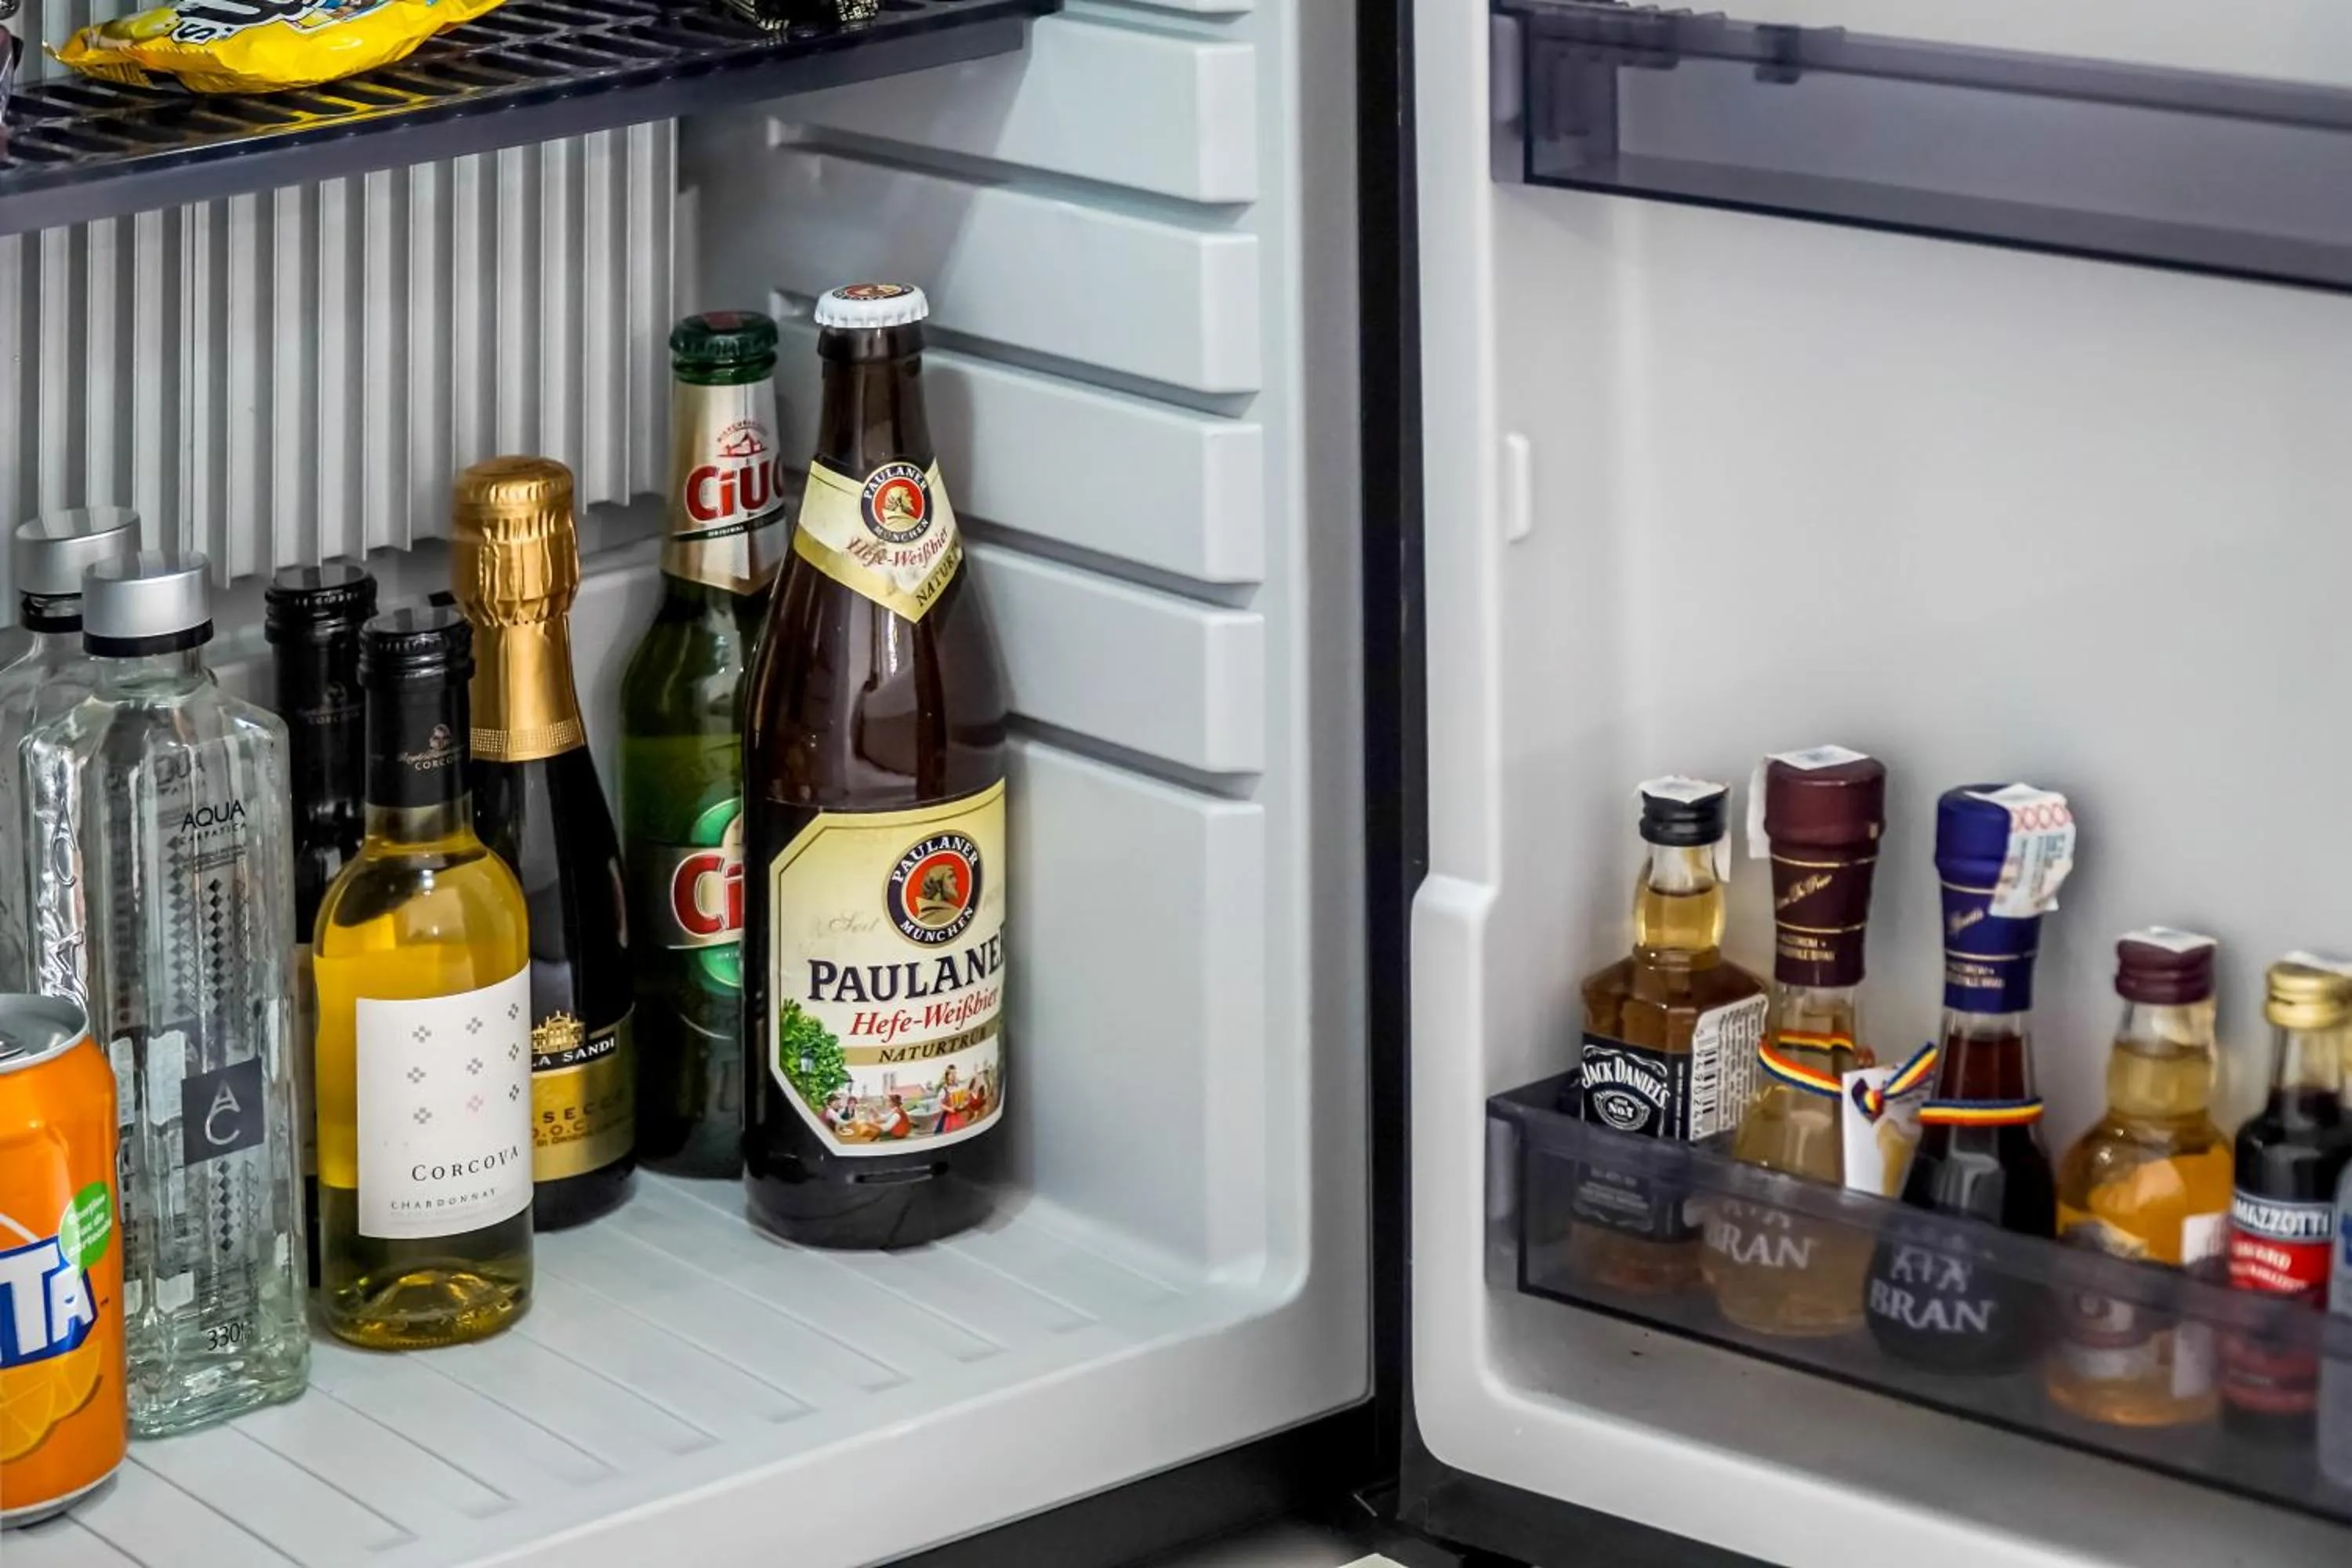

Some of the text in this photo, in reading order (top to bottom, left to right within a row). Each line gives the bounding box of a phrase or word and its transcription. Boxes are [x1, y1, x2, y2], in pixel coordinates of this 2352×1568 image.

[864, 466, 928, 499] PAULANER
[181, 799, 245, 833] AQUA
[892, 836, 978, 884] PAULANER
[808, 932, 1003, 1004] PAULANE
[848, 985, 999, 1044] Hefe-Weißbier
[562, 1036, 615, 1063] SANDI
[1581, 1061, 1614, 1089] JACK
[1614, 1055, 1671, 1109] DANIEL'S
[412, 1145, 518, 1181] CORCOVA
[391, 1188, 495, 1210] CHARDONNAY
[0, 1241, 93, 1357] TA
[1869, 1278, 1998, 1333] BRAN
